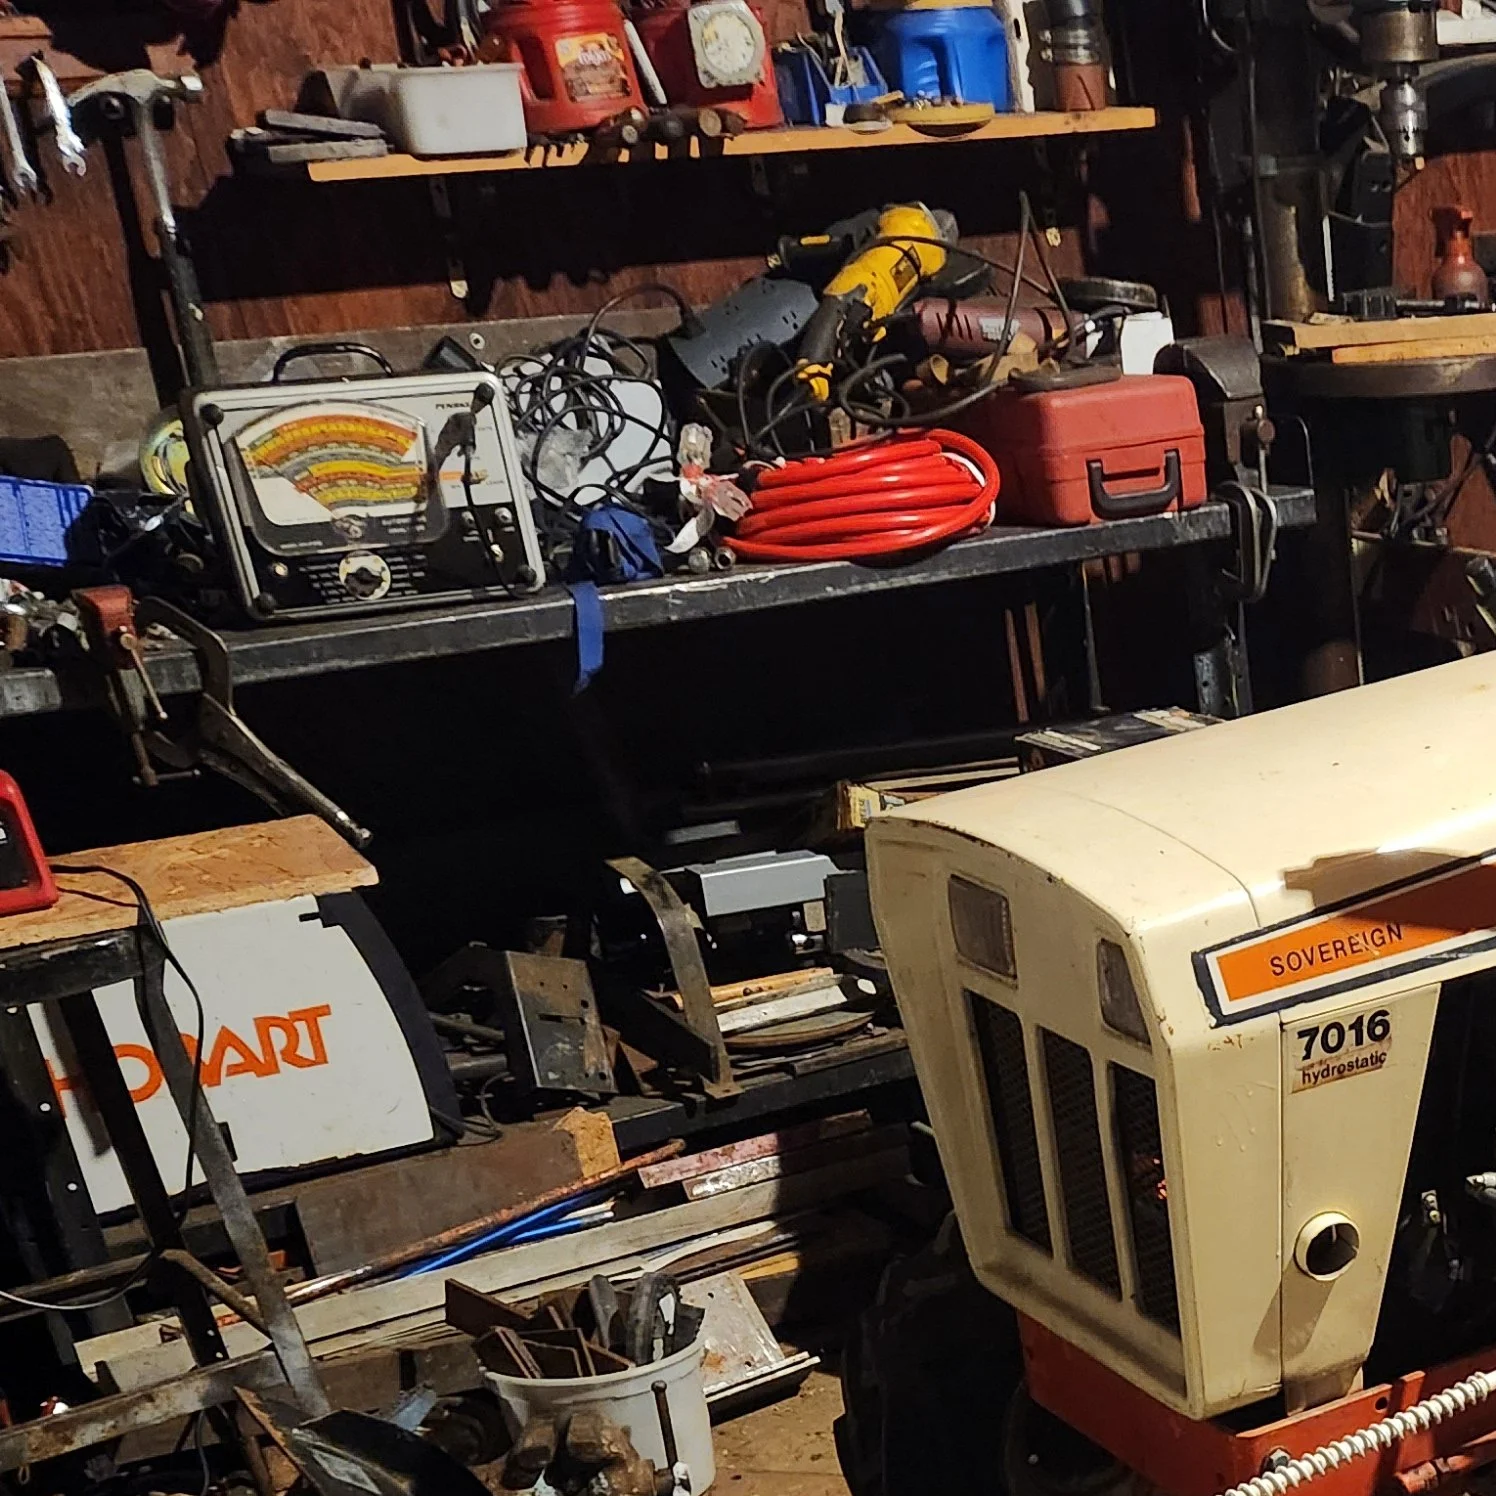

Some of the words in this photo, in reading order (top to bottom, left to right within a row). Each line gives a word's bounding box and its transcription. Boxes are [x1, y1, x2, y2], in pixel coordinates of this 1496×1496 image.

[1270, 922, 1403, 977] SOVEREIGN
[1296, 1009, 1391, 1061] 7016
[1302, 1050, 1387, 1086] hydrostatic
